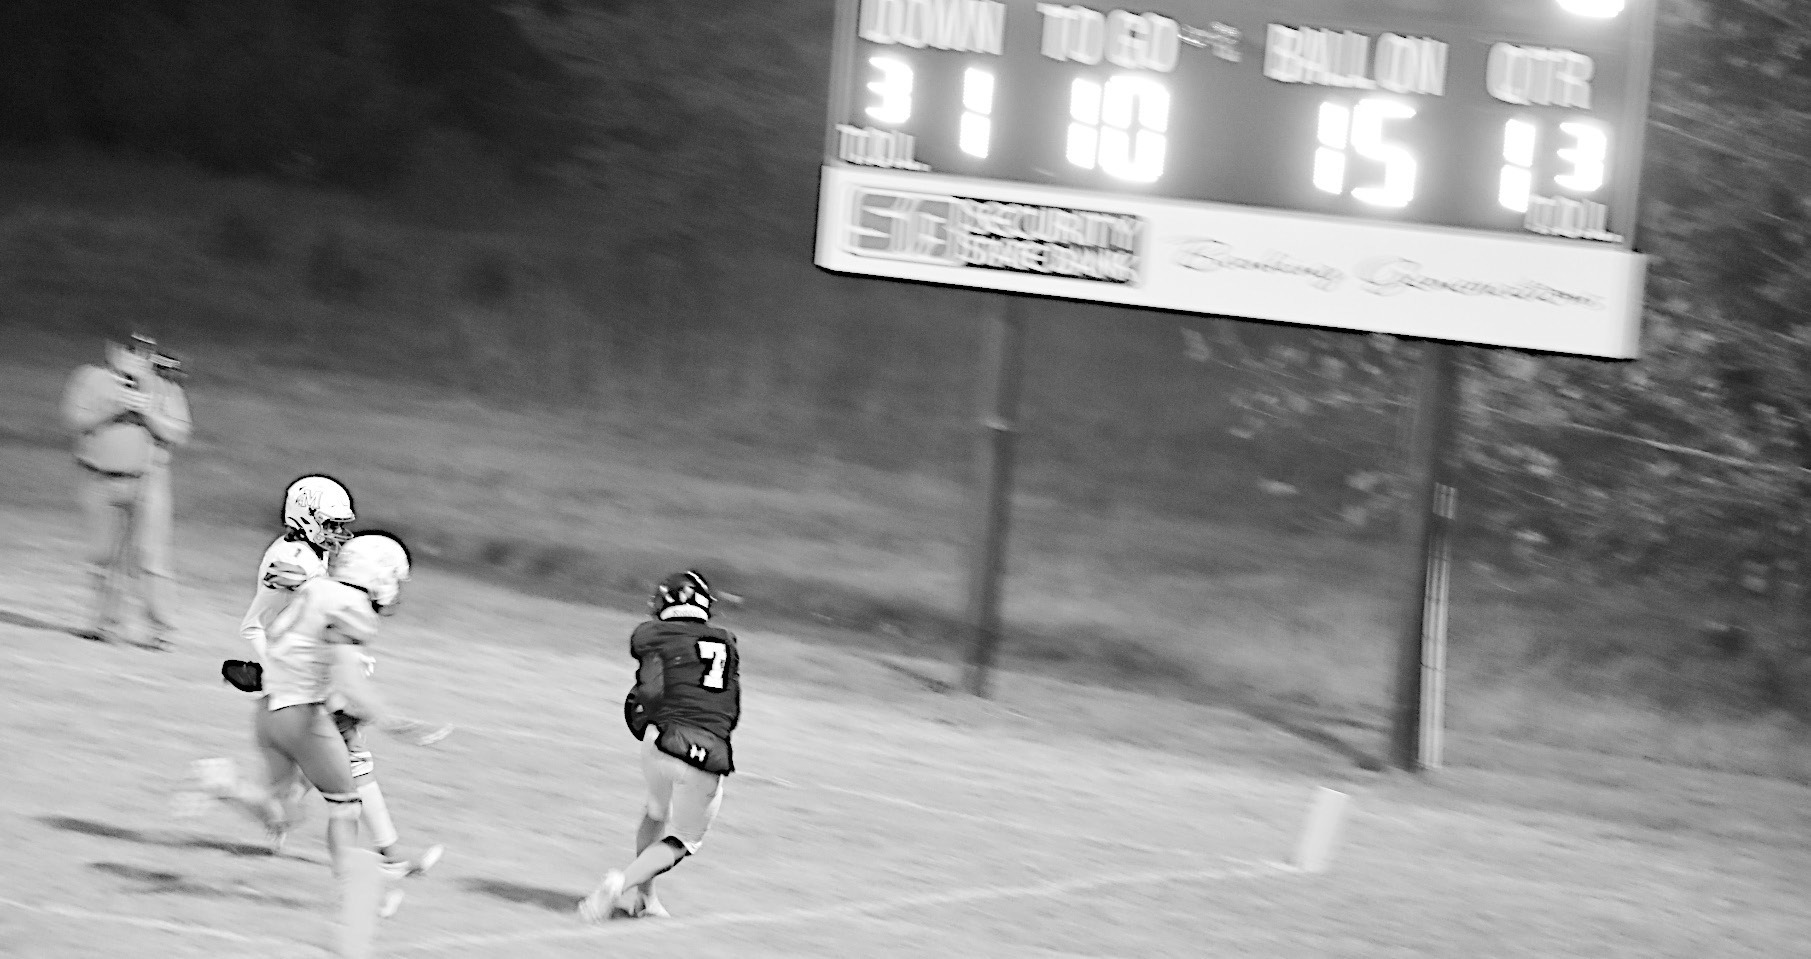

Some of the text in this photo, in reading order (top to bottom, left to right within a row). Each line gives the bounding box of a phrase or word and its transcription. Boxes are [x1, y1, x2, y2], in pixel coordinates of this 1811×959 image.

[858, 0, 1006, 55] DOWN
[1036, 3, 1180, 73] TO GO
[1263, 23, 1449, 97] BALL ON
[865, 56, 914, 123] 3
[1486, 42, 1595, 109] QTR
[959, 67, 995, 158] 1
[1066, 74, 1170, 182] 10
[1313, 97, 1417, 207] 15
[1498, 118, 1536, 213] 1
[1554, 121, 1608, 192] 3
[958, 199, 1146, 254] SECURITY
[697, 640, 727, 689] 7
